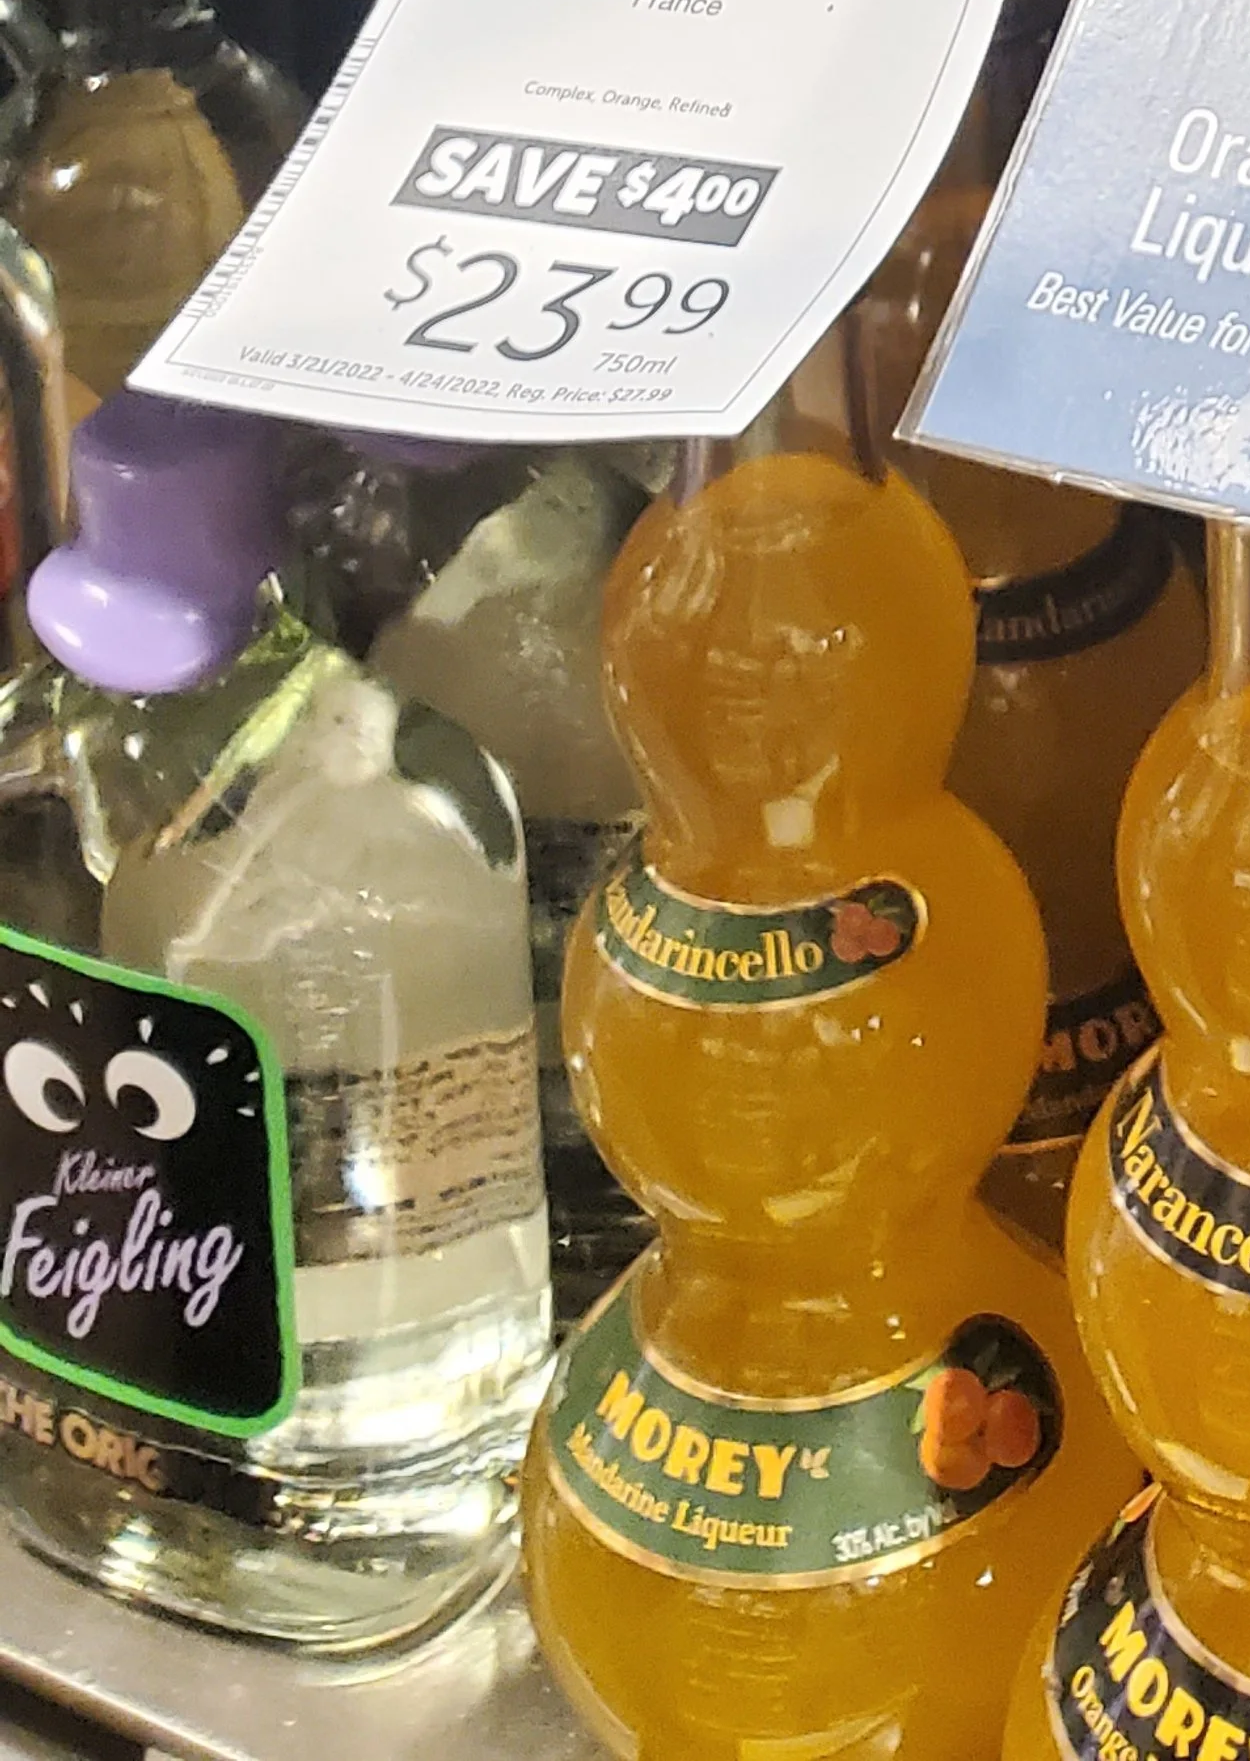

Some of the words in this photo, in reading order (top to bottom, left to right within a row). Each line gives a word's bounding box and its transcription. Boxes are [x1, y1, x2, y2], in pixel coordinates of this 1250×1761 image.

[524, 80, 596, 103] Complex,
[602, 89, 662, 113] Orange,
[668, 95, 732, 118] Refined
[414, 136, 619, 215] SAVE
[1026, 271, 1109, 315] Best
[1110, 289, 1207, 345] Value
[240, 345, 284, 367] Valid
[285, 353, 384, 381] 3/21/2022
[506, 383, 546, 402] Reg.
[552, 388, 606, 404] Price:
[607, 386, 673, 404] $27.99
[593, 352, 678, 376] 750ml
[54, 1149, 156, 1196] Kleiner
[0, 1188, 244, 1339] Feigling
[596, 1369, 797, 1500] MOREY
[671, 1499, 794, 1550] Liqueur
